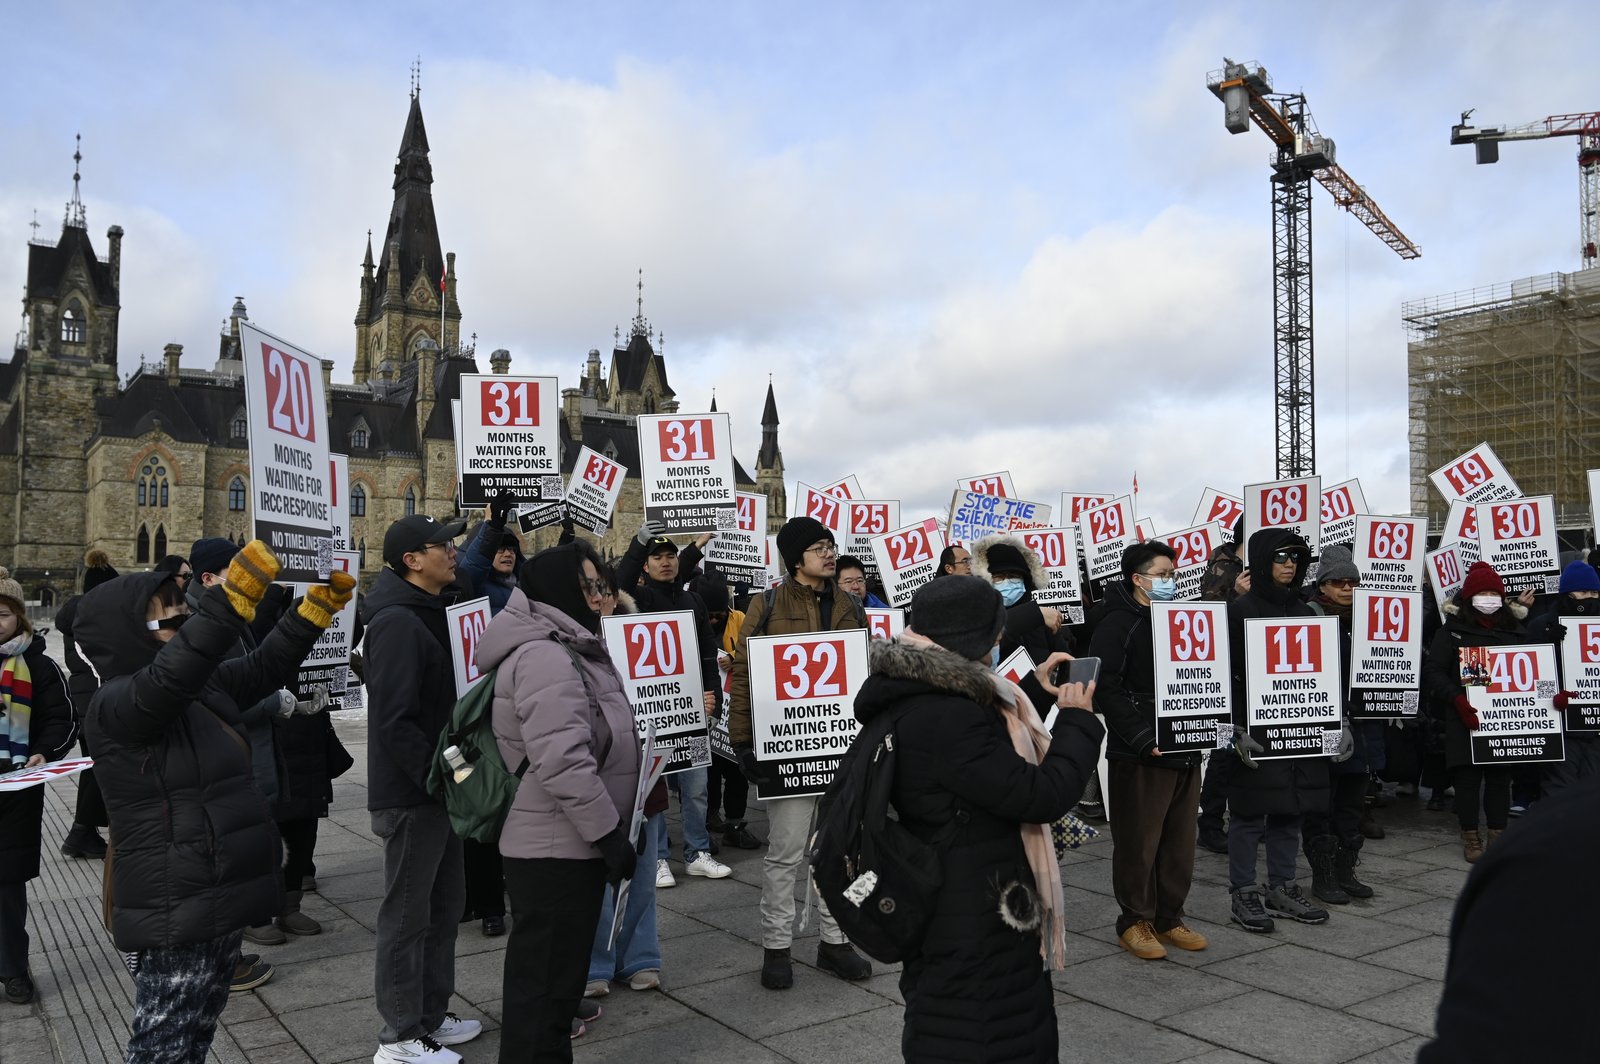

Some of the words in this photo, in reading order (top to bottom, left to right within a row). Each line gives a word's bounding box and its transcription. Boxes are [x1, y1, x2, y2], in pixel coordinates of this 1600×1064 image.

[269, 350, 309, 438] 20
[488, 382, 533, 426] 31
[487, 432, 534, 443] MONTHS
[665, 420, 709, 461] 31
[274, 443, 312, 471] MONTHS
[476, 445, 522, 456] WAITING
[525, 445, 546, 456] FOR
[469, 458, 494, 469] IRCC
[495, 458, 552, 469] RESPONSE
[588, 458, 613, 489] 31
[666, 465, 710, 477] MONTHS
[1451, 458, 1486, 493] 19
[265, 466, 304, 493] WAITING
[306, 478, 322, 497] FOR
[480, 477, 494, 487] NO
[495, 477, 542, 487] TIMELINES
[656, 478, 700, 490] WAITING
[702, 477, 723, 488] FOR
[484, 488, 498, 497] NO
[582, 483, 605, 499] MONTHS
[651, 491, 674, 502] IRCC
[677, 488, 730, 501] RESPONSE
[1465, 482, 1496, 502] MONTHS
[1494, 485, 1508, 498] FOR
[568, 493, 580, 504] IRCC
[580, 499, 608, 517] RESPONSE
[574, 488, 597, 503] WAITING
[597, 499, 608, 509] FOR
[963, 492, 1000, 512] STOP
[1004, 500, 1036, 519] THE
[1266, 486, 1302, 525] 68
[260, 491, 282, 514] IRCC
[284, 496, 328, 521] RESPONSE
[809, 494, 837, 527] 27
[1321, 489, 1349, 523] 30
[539, 511, 560, 523] RESULTS
[662, 509, 675, 518] NO
[855, 505, 885, 534] 25
[1213, 499, 1244, 530] 27
[667, 519, 679, 528] NO
[681, 517, 717, 527] RESULTS
[1093, 506, 1120, 543] 29
[1323, 519, 1355, 534] MONTHS
[1497, 503, 1535, 539] 30
[272, 531, 283, 547] NO
[721, 532, 751, 543] MONTHS
[1374, 522, 1409, 559] 68
[714, 541, 743, 552] WAITING
[744, 544, 759, 554] FOR
[891, 529, 928, 569] 22
[1029, 533, 1062, 567] 30
[1097, 540, 1124, 554] MONTHS
[1173, 531, 1208, 568] 29
[1499, 540, 1538, 552] MONTHS
[289, 554, 319, 571] RESULTS
[709, 550, 725, 560] IRCC
[725, 552, 762, 564] RESPONSE
[1093, 551, 1119, 566] WAITING
[1491, 551, 1529, 563] WAITING
[1530, 549, 1548, 559] FOR
[725, 565, 754, 575] TIMELINES
[899, 563, 933, 581] MONTHS
[1091, 566, 1104, 576] IRCC
[1371, 562, 1406, 572] MONTHS
[1437, 554, 1458, 586] 30
[1508, 559, 1554, 571] RESPONSE
[727, 574, 752, 583] RESULTS
[894, 576, 927, 593] WAITING
[1057, 580, 1072, 589] FOR
[1361, 573, 1396, 583] WAITING
[1397, 574, 1413, 583] FOR
[1508, 574, 1546, 584] TIMELINES
[893, 591, 911, 604] IRCC
[1038, 590, 1077, 600] RESPONSE
[1373, 597, 1404, 641] 19
[331, 632, 345, 643] FOR
[1174, 611, 1210, 661] 39
[631, 622, 677, 678] 20
[1273, 626, 1314, 673] 11
[1586, 624, 1600, 663] 5
[310, 646, 348, 660] RESPONSE
[1370, 647, 1404, 658] MONTHS
[782, 642, 840, 699] 32
[1361, 660, 1395, 670] WAITING
[1396, 660, 1412, 671] FOR
[1491, 652, 1534, 692] 40
[298, 671, 308, 682] NO
[1176, 667, 1212, 680] MONTHS
[1356, 672, 1374, 683] IRCC
[1374, 673, 1415, 684] RESPONSE
[299, 684, 308, 695] NO
[636, 681, 681, 699] MONTHS
[1167, 683, 1203, 696] WAITING
[1205, 682, 1221, 694] FOR
[1272, 678, 1317, 691] MONTHS
[1262, 693, 1306, 706] WAITING
[1308, 692, 1328, 703] FOR
[1363, 692, 1372, 700] NO
[1492, 696, 1536, 707] MONTHS
[673, 696, 693, 711] FOR
[1162, 699, 1182, 711] IRCC
[1183, 697, 1226, 710] RESPONSE
[1365, 703, 1375, 711] NO
[1375, 702, 1402, 712] RESULTS
[784, 703, 841, 720] MONTHS
[1255, 708, 1279, 720] IRCC
[1281, 705, 1335, 719] RESPONSE
[1482, 709, 1525, 720] WAITING
[1528, 708, 1548, 718] FOR
[1581, 707, 1591, 716] NO
[770, 720, 827, 737] WAITING
[830, 718, 857, 732] FOR
[1172, 721, 1182, 731] NO
[1183, 719, 1219, 730] TIMELINES
[1501, 720, 1555, 731] RESPONSE
[1584, 717, 1595, 725] NO
[710, 730, 720, 739] NO
[1175, 734, 1186, 744] NO
[1187, 731, 1217, 743] RESULTS
[1266, 729, 1279, 739] NO
[1281, 727, 1325, 738] TIMELINES
[711, 739, 721, 748] NO
[763, 740, 793, 755] IRCC
[795, 734, 856, 752] RESPONS
[1271, 740, 1284, 750] NO
[1285, 738, 1322, 749] RESULTS
[1488, 739, 1500, 747] NO
[1501, 737, 1546, 746] TIMELINES
[1493, 749, 1505, 757] NO
[1507, 747, 1543, 756] RESULTS
[778, 763, 794, 775] NO
[795, 760, 840, 773] TIMELIN
[784, 777, 800, 788] NO
